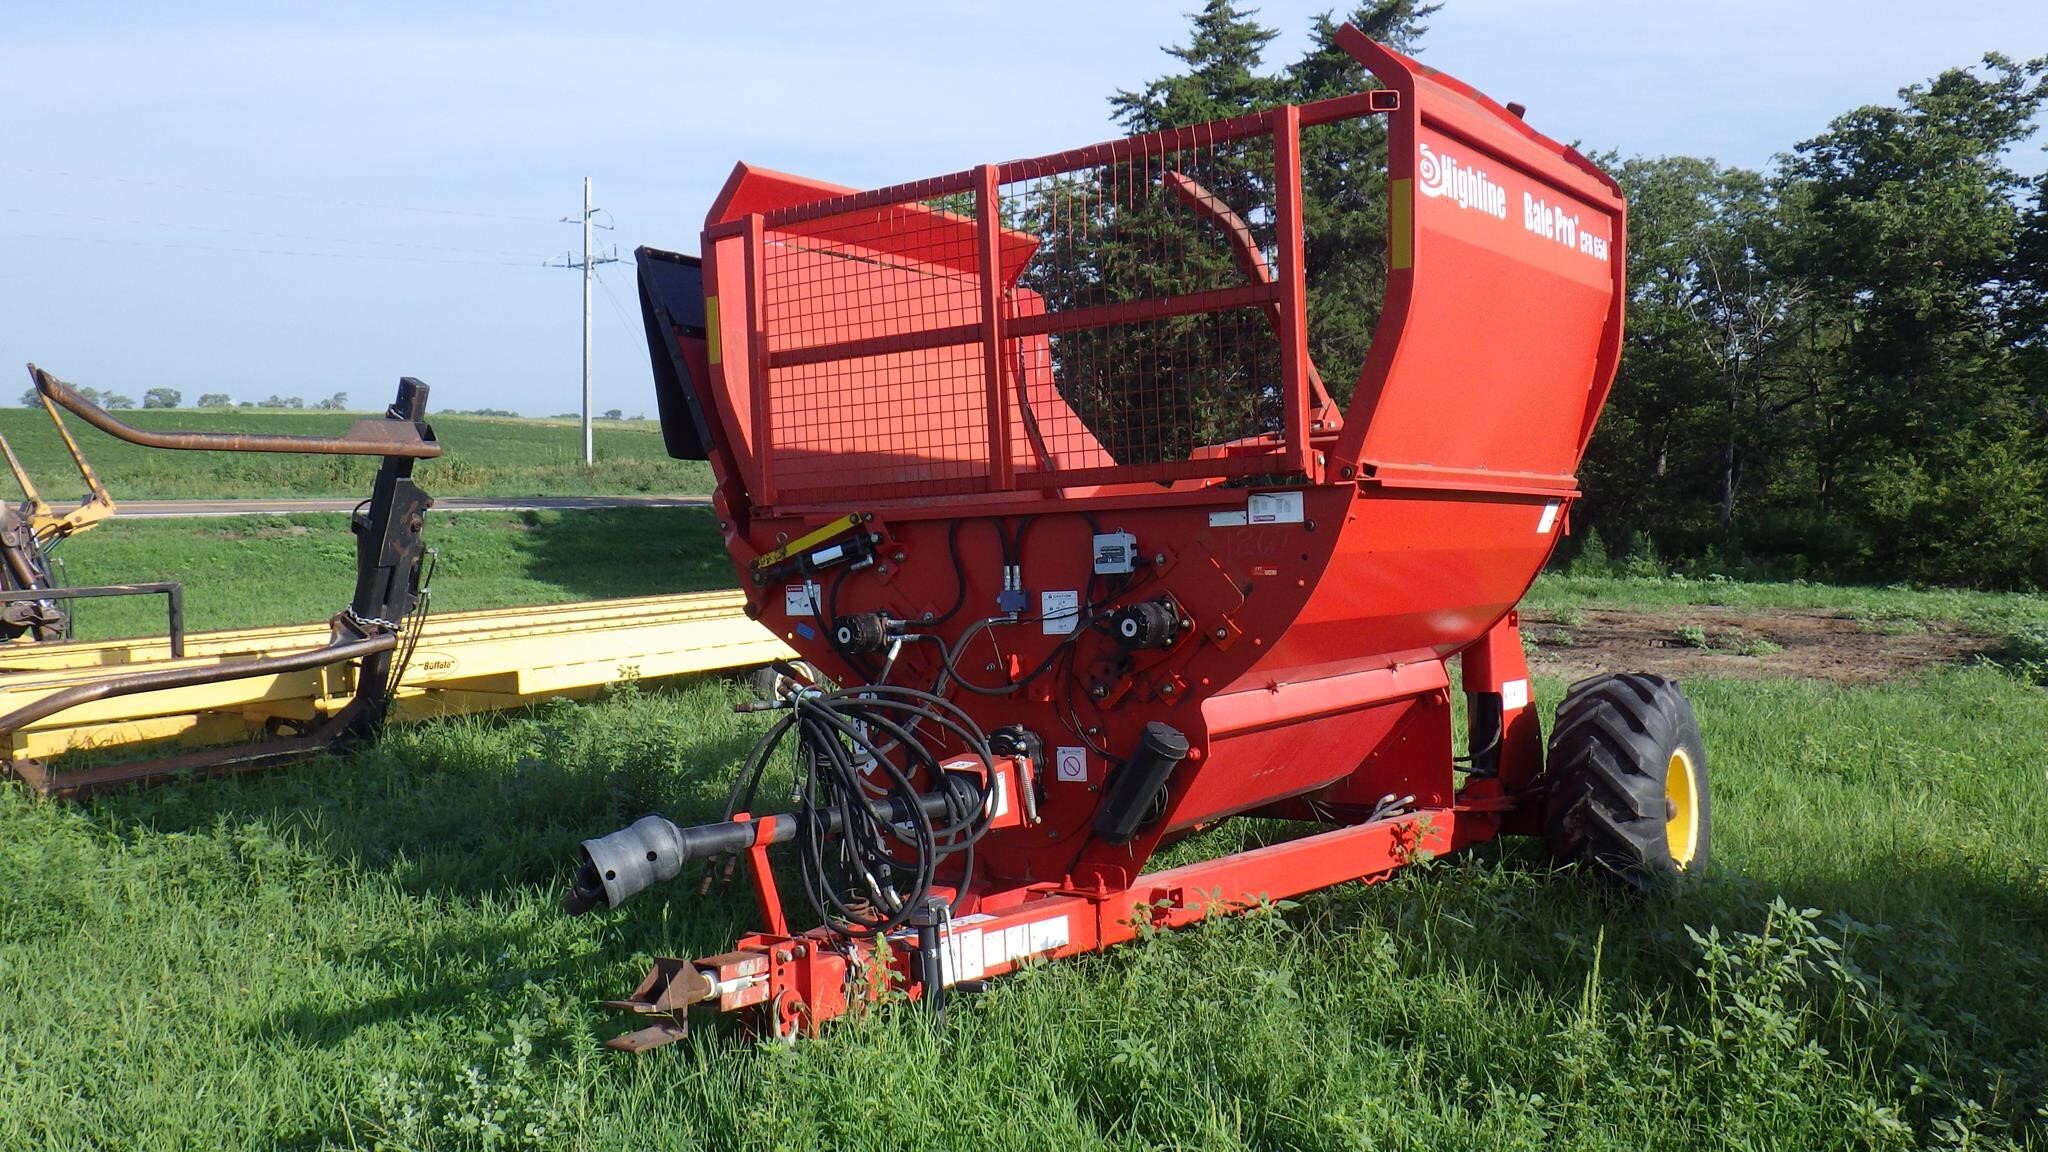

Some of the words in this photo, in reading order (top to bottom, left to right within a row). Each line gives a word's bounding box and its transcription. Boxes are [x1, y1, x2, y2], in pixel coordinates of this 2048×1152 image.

[1440, 153, 1507, 220] Highline
[1523, 191, 1553, 240] Bale
[1594, 237, 1608, 262] 650
[423, 661, 451, 670] Buffalo
